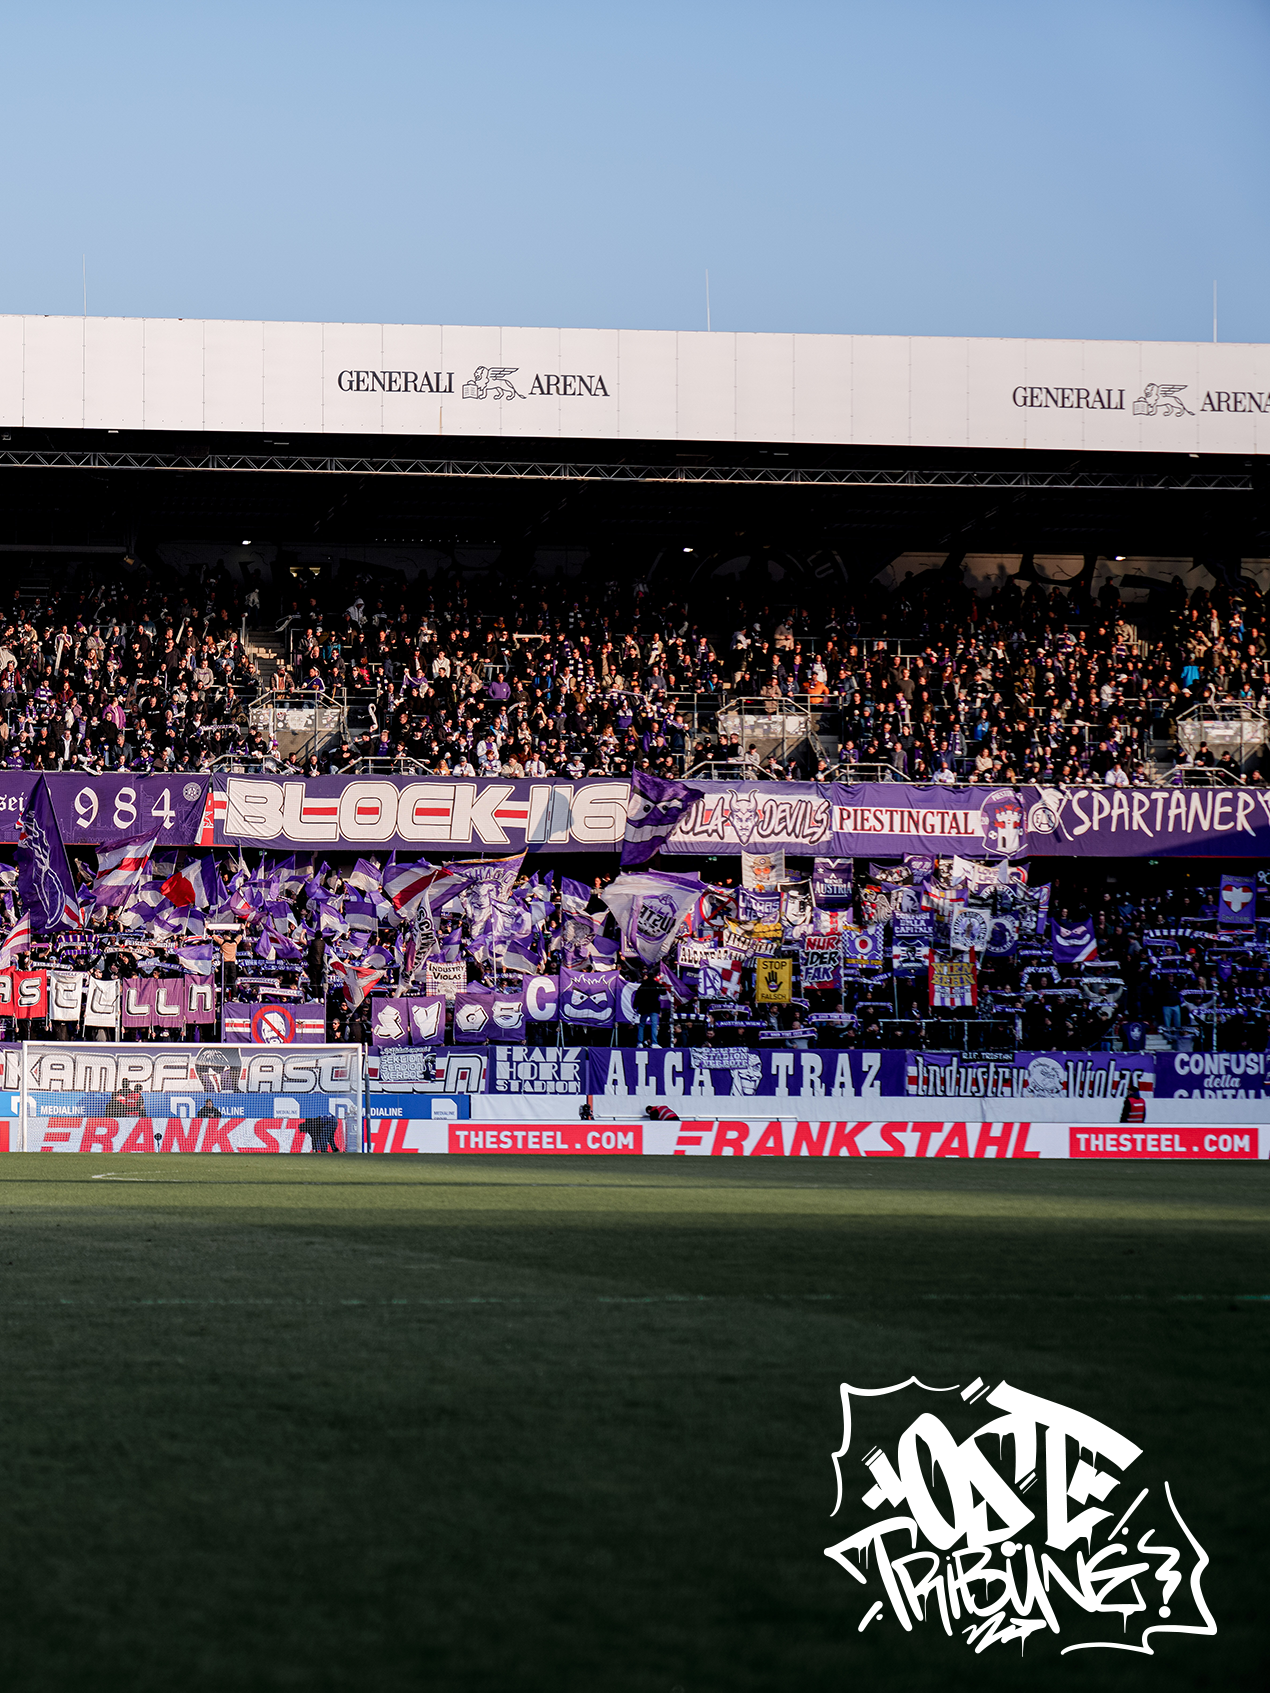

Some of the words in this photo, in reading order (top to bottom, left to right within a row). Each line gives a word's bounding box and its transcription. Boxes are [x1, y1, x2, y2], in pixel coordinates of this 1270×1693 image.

[337, 370, 455, 394] GENERALI
[528, 373, 610, 397] ARENA
[1012, 386, 1126, 410] GENERALI
[74, 787, 176, 829] 984
[224, 778, 514, 845] BLOCK
[1072, 790, 1256, 838] SPARTANER
[758, 798, 831, 846] DEVILS
[838, 807, 976, 836] PIESTINGTAL
[815, 881, 852, 894] AUSTRIA
[805, 936, 839, 951] NUR
[762, 961, 787, 970] STOP
[809, 950, 840, 966] DER
[433, 972, 461, 980] VIOLAS
[803, 965, 836, 982] FAK
[931, 962, 975, 975] WIEN
[495, 1046, 581, 1062] FRANZ
[1, 1052, 193, 1093] KAMPF
[495, 1062, 581, 1079] HORR
[1174, 1053, 1265, 1075] CONFUSI
[916, 1054, 1029, 1097] Industry
[1204, 1074, 1241, 1088] della
[495, 1079, 581, 1093] STADION
[40, 1106, 86, 1115] MEDIALINE
[361, 1107, 403, 1116] MDIALINE
